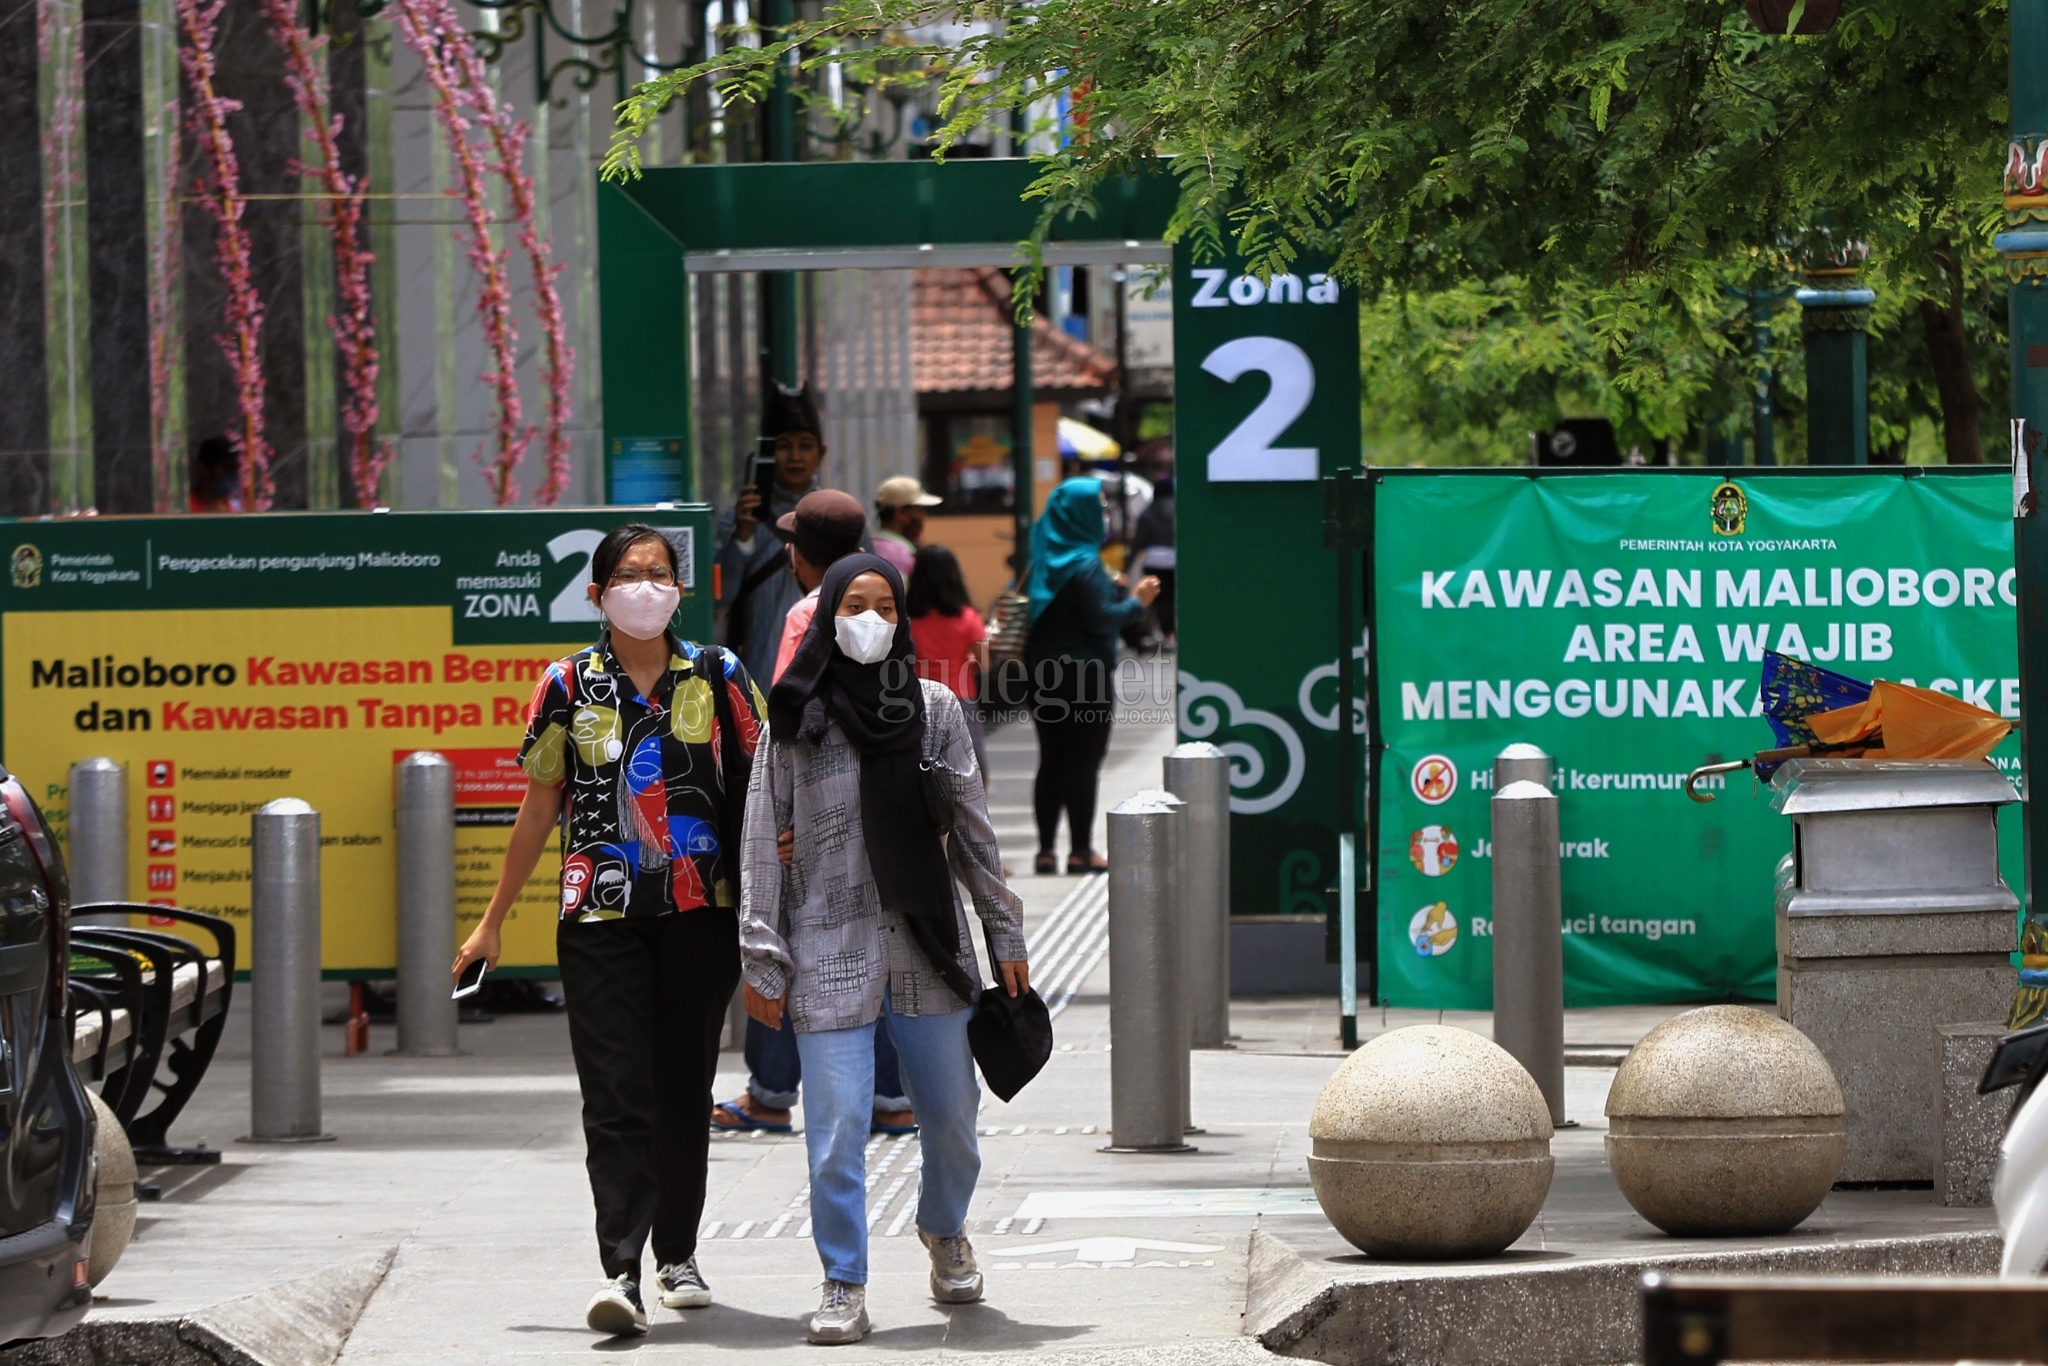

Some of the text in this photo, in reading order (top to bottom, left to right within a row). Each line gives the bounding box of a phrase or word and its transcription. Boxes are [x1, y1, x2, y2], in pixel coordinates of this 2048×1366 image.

[1190, 267, 1340, 307] Zona
[1200, 335, 1320, 482] 2
[1620, 538, 1837, 551] PEMERINTAH KOTA YOGYAKARTA
[158, 552, 441, 573] Pengecekan pengunjung Malioboro
[496, 550, 541, 567] Anda
[456, 572, 541, 590] memasuki
[1421, 568, 1702, 609] KAWASAN
[464, 595, 541, 618] ZONA
[1562, 622, 1894, 663] AREA WAJIB
[32, 655, 237, 689] Malioboro
[246, 655, 434, 687] Kawasan
[1401, 678, 1763, 721] MENGGUNAK
[75, 700, 151, 732] dan
[162, 700, 349, 732] Kawasan
[356, 698, 483, 736] Tanpa
[181, 767, 293, 781] Memakai masker
[182, 801, 268, 817] Menjaga jara
[182, 835, 237, 849] Mencuci
[341, 834, 382, 848] sabun
[182, 868, 243, 886] Menjauhi
[1562, 914, 1697, 940] uci tangan
